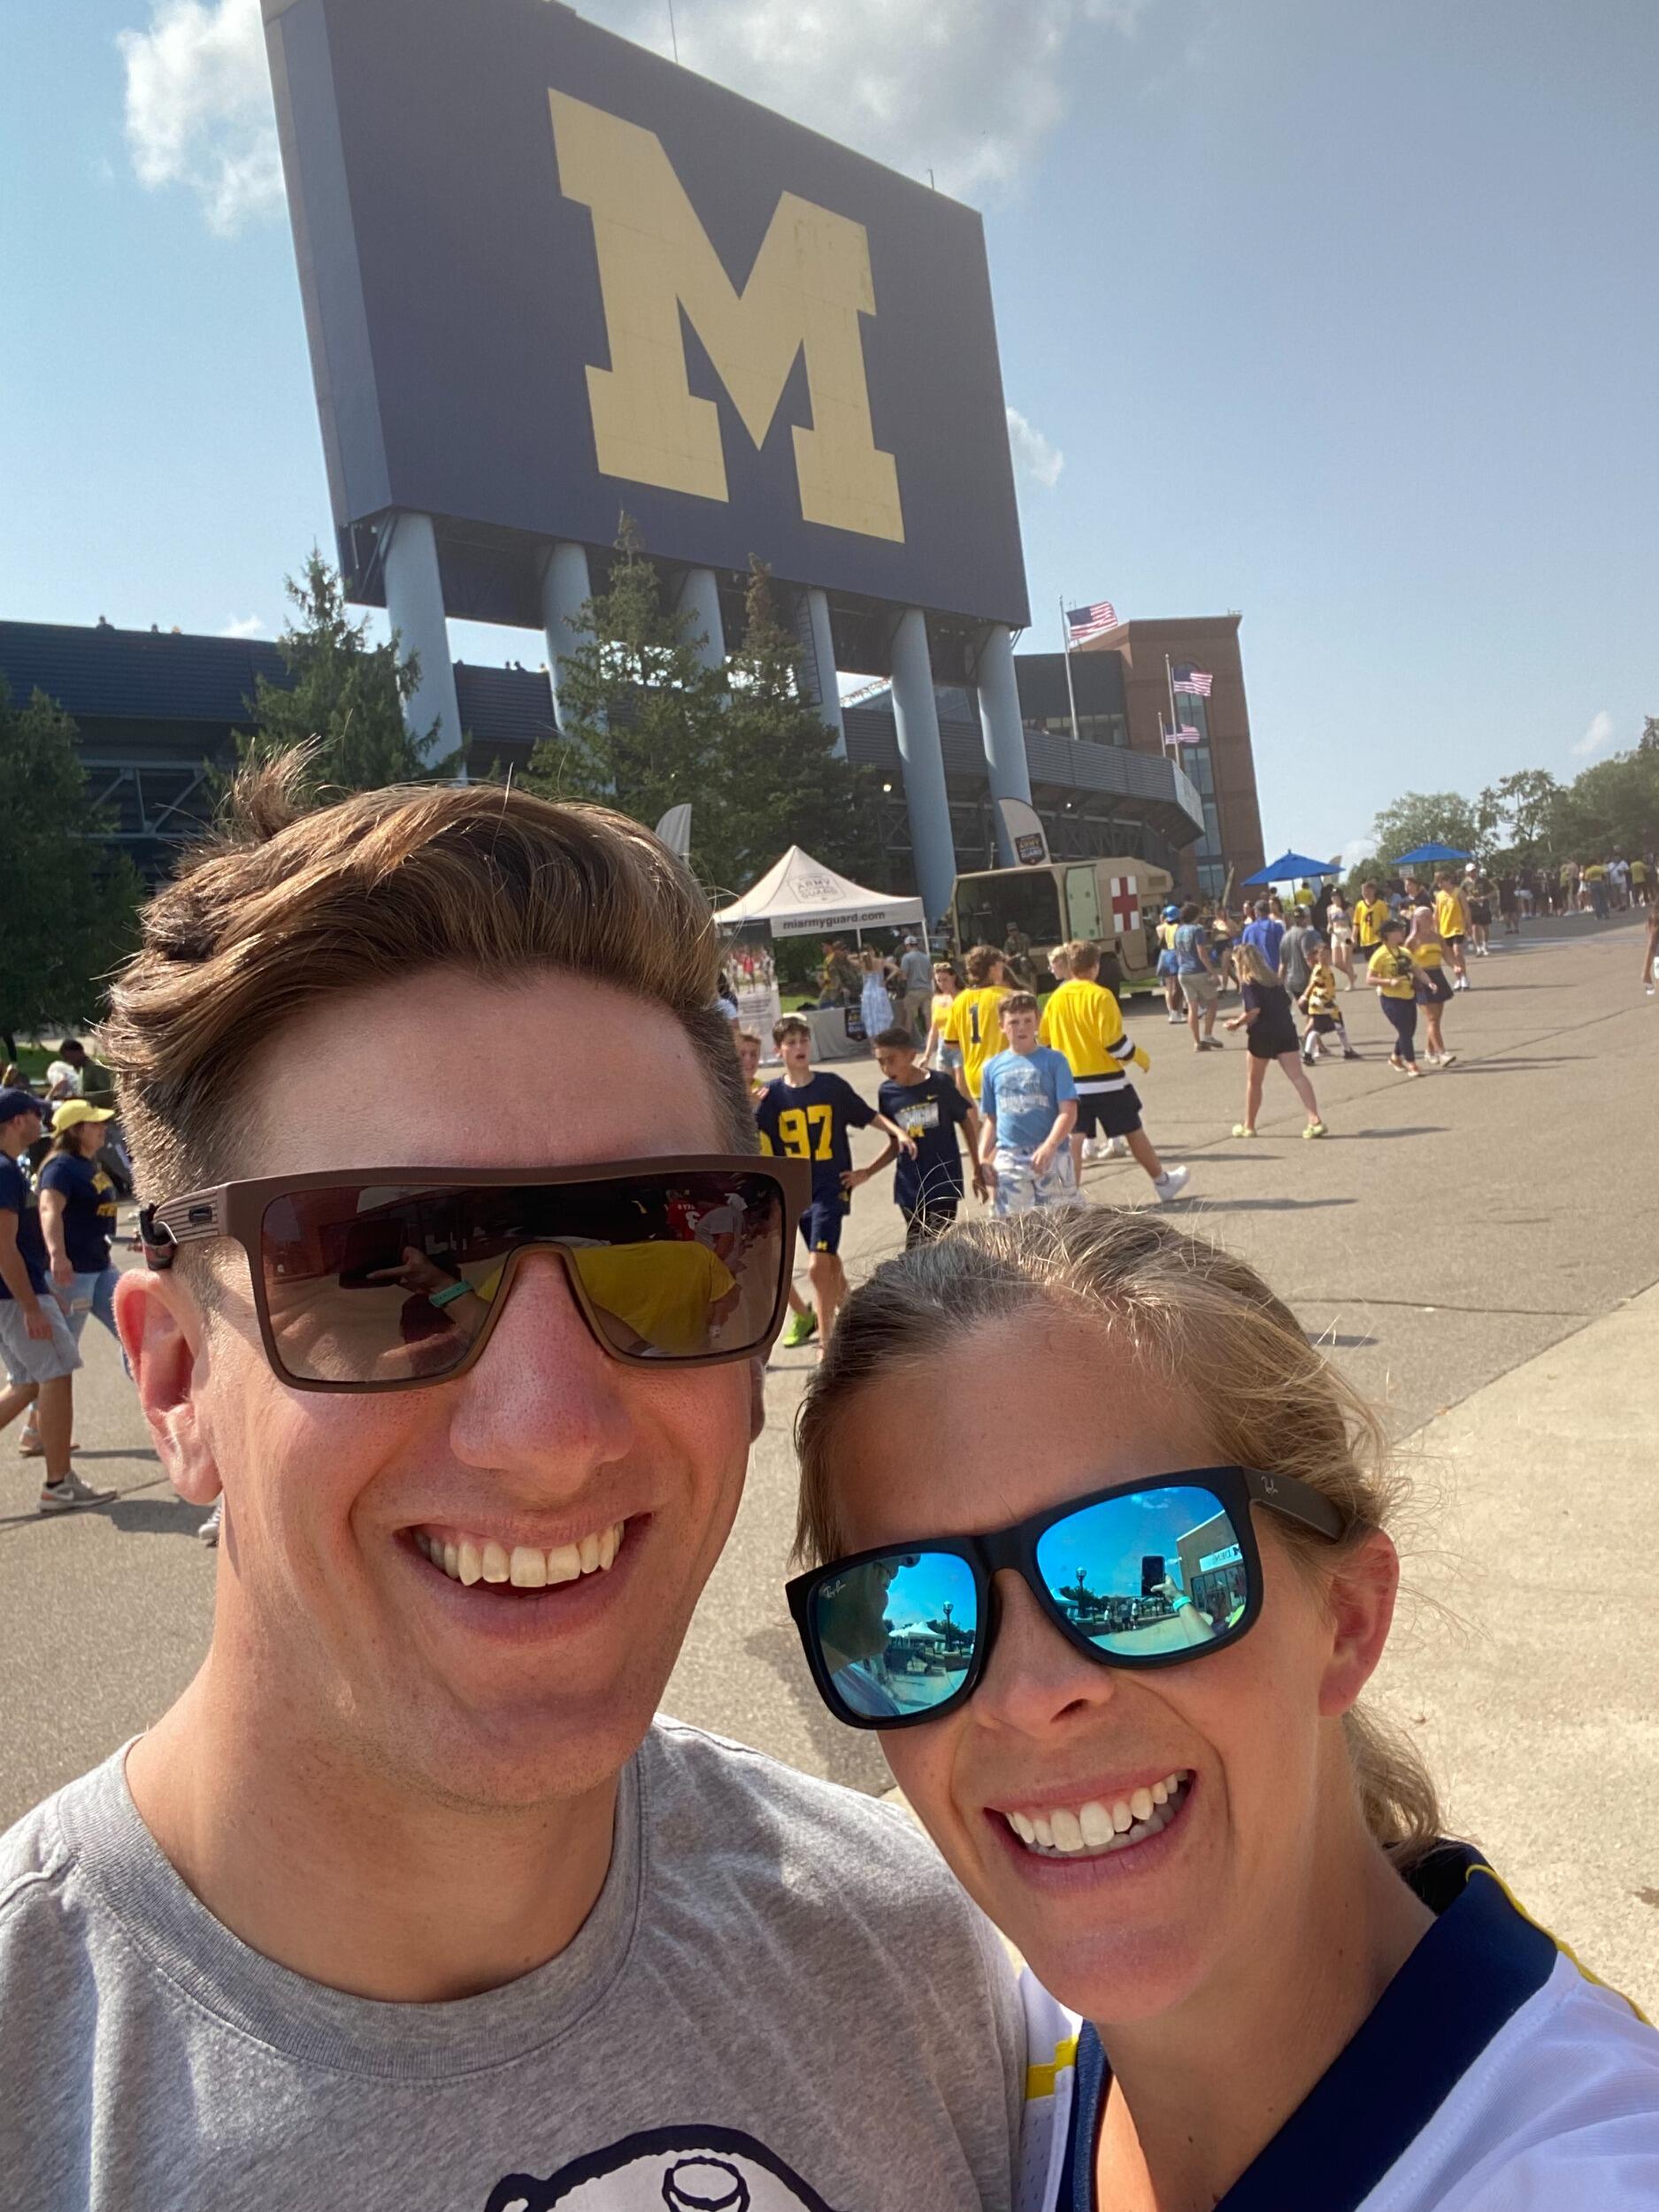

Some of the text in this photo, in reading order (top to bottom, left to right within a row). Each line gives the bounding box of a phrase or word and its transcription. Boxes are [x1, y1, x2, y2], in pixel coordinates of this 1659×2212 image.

[548, 87, 905, 543] M
[798, 879, 830, 890] ARMY
[783, 911, 885, 929] miarmyguard.com
[970, 1004, 981, 1043] 1
[779, 1104, 833, 1161] 97
